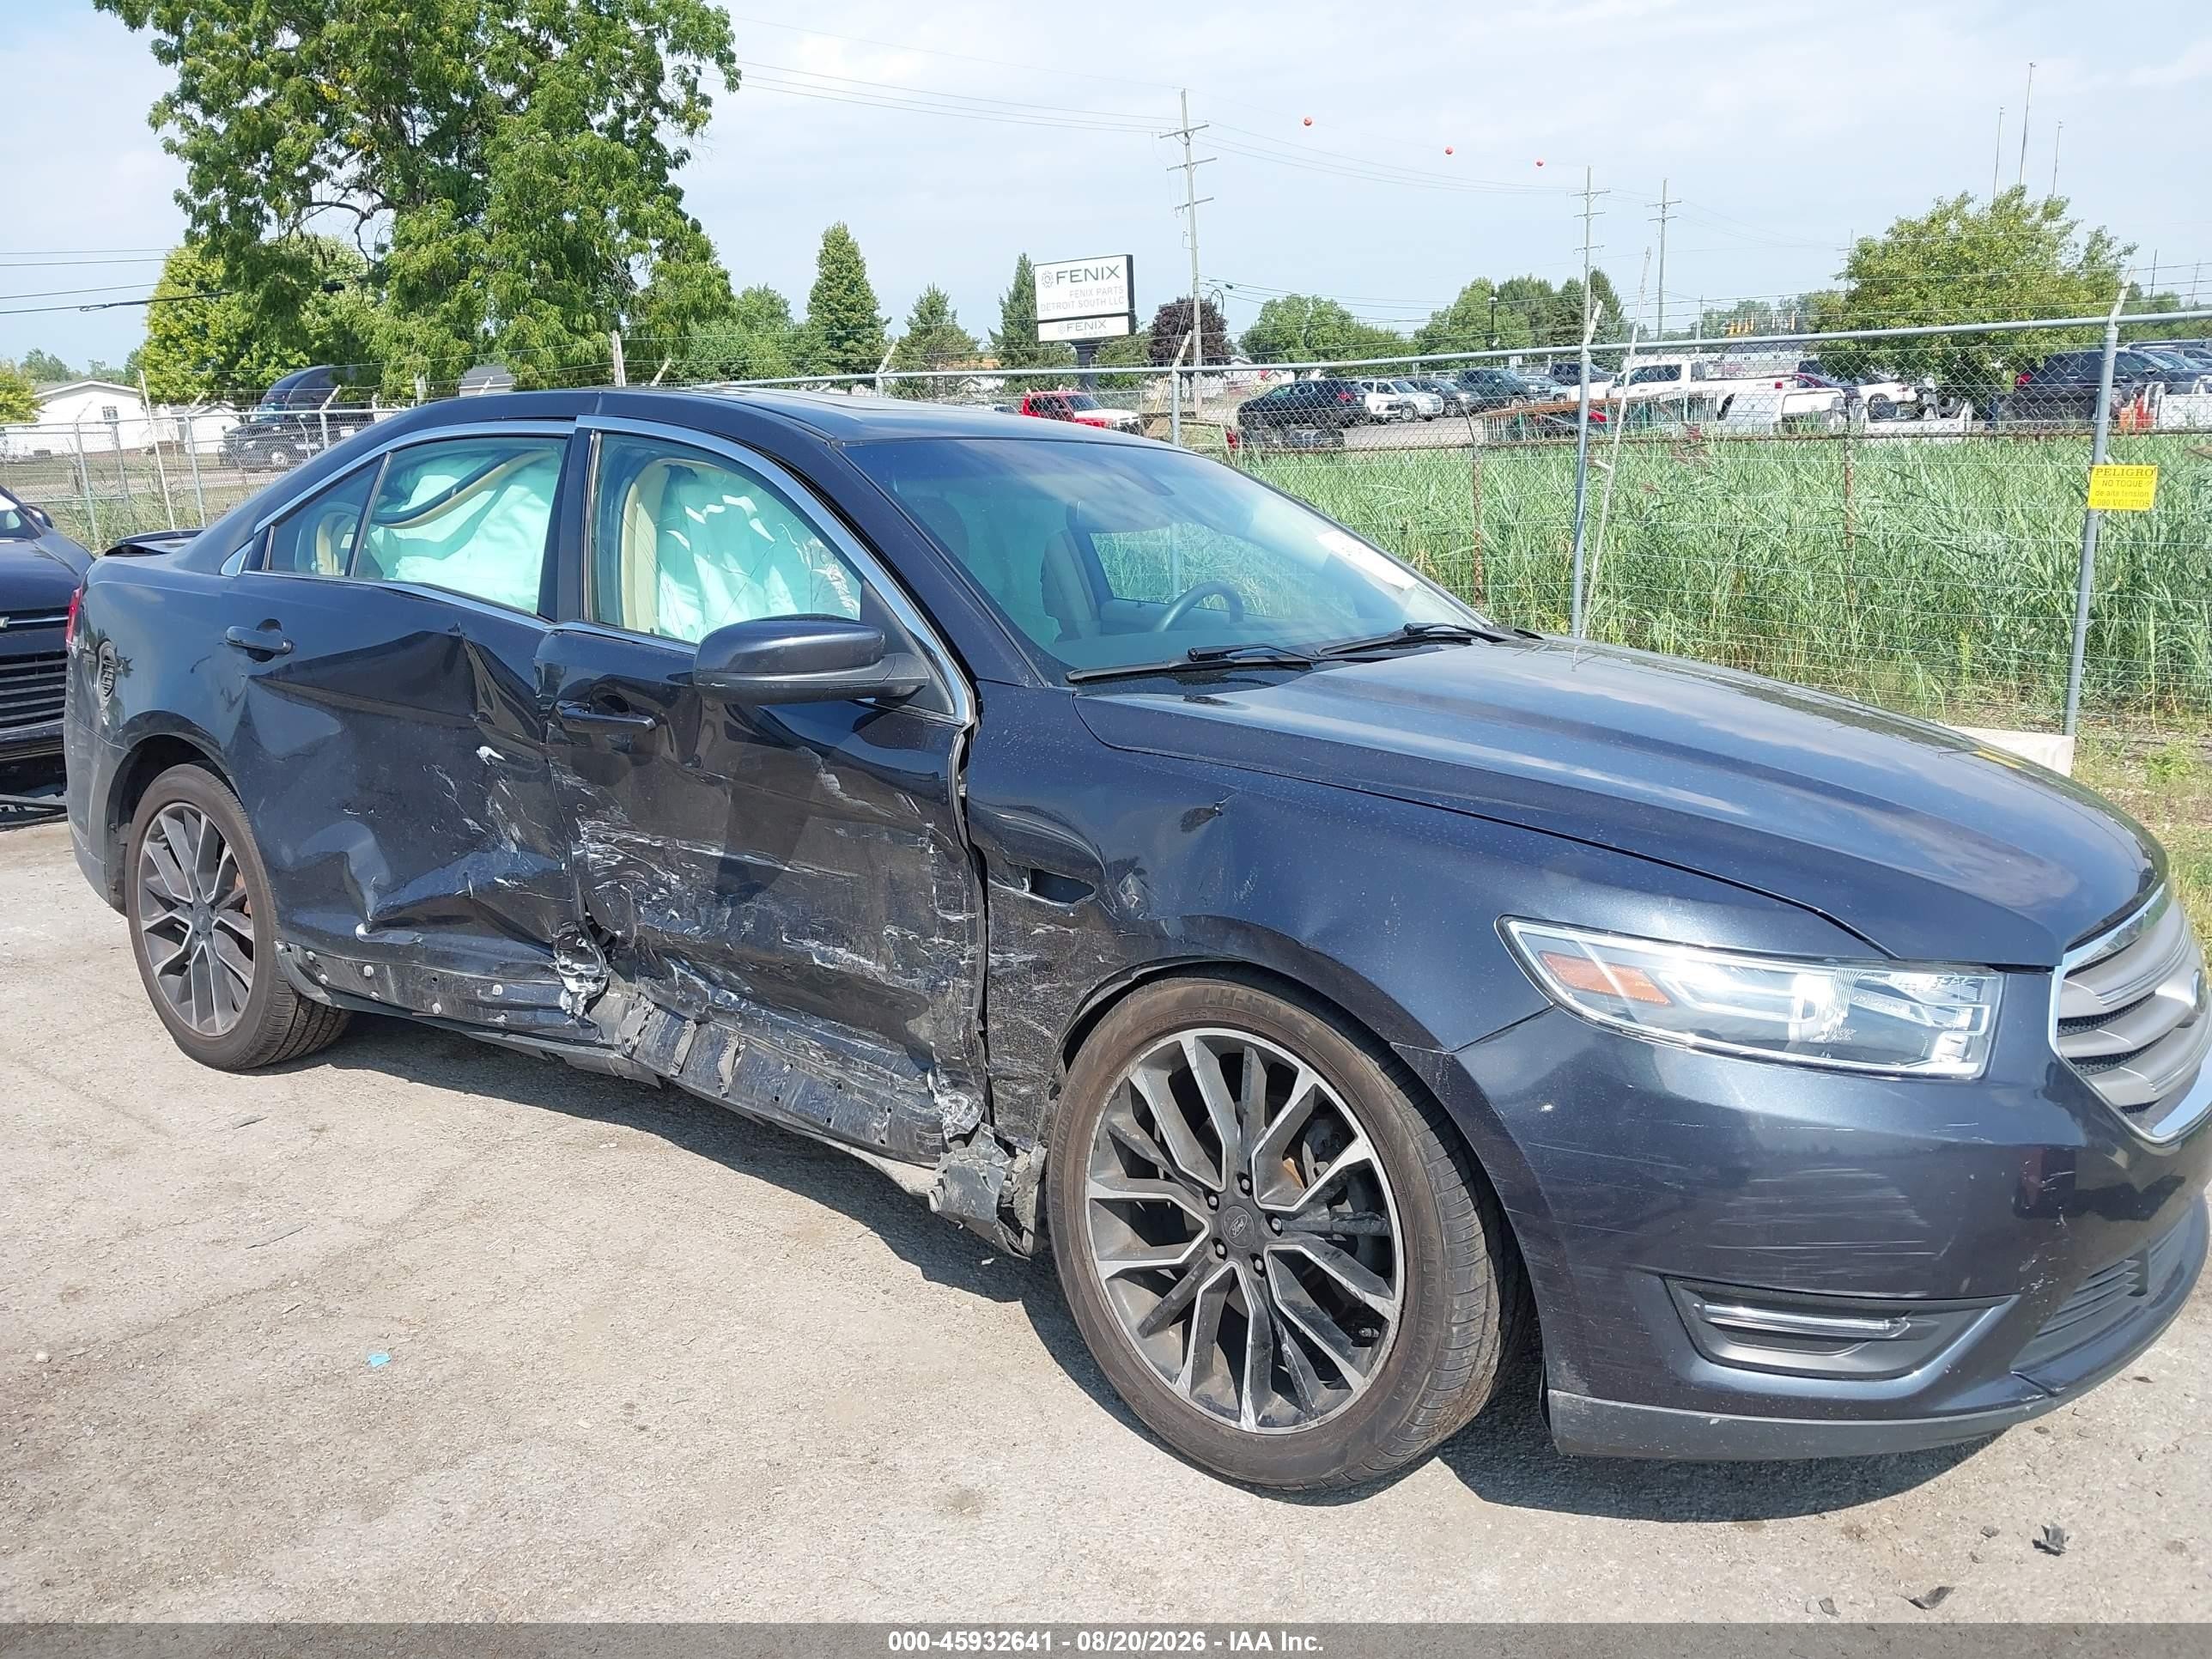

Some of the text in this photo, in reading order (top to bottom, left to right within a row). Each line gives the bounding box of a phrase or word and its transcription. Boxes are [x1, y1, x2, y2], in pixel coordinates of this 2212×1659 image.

[1056, 264, 1121, 285] FENIX
[1069, 285, 1124, 299] FENIX PARTS
[1040, 295, 1125, 312] DETROIT SOUTH LLC
[1066, 319, 1107, 332] FENIX
[2095, 468, 2154, 477] PELIGRO
[2116, 479, 2143, 488] TOQUE
[2112, 499, 2151, 507] VOLTIOS
